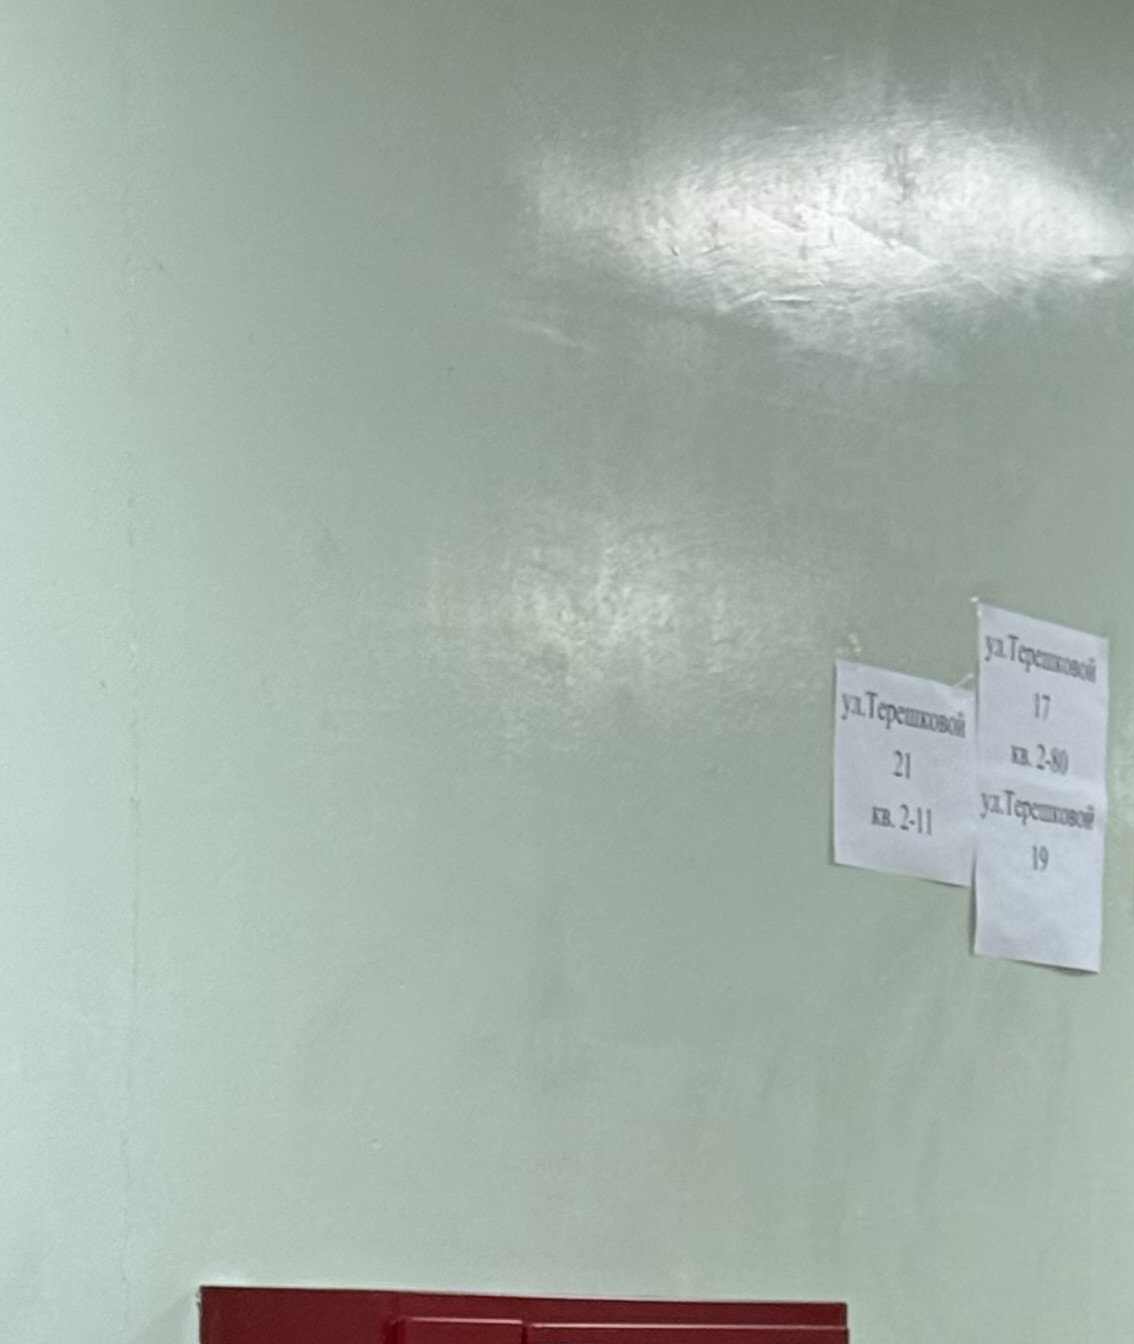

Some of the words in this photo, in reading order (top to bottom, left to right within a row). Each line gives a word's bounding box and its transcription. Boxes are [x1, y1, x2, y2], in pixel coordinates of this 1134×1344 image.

[1034, 692, 1051, 720] 17
[892, 750, 911, 779] 21
[1011, 745, 1032, 767] кв.
[1036, 743, 1069, 776] 2-80
[871, 806, 896, 828] кв.
[899, 803, 932, 836] 2-11
[1032, 845, 1049, 871] 19
